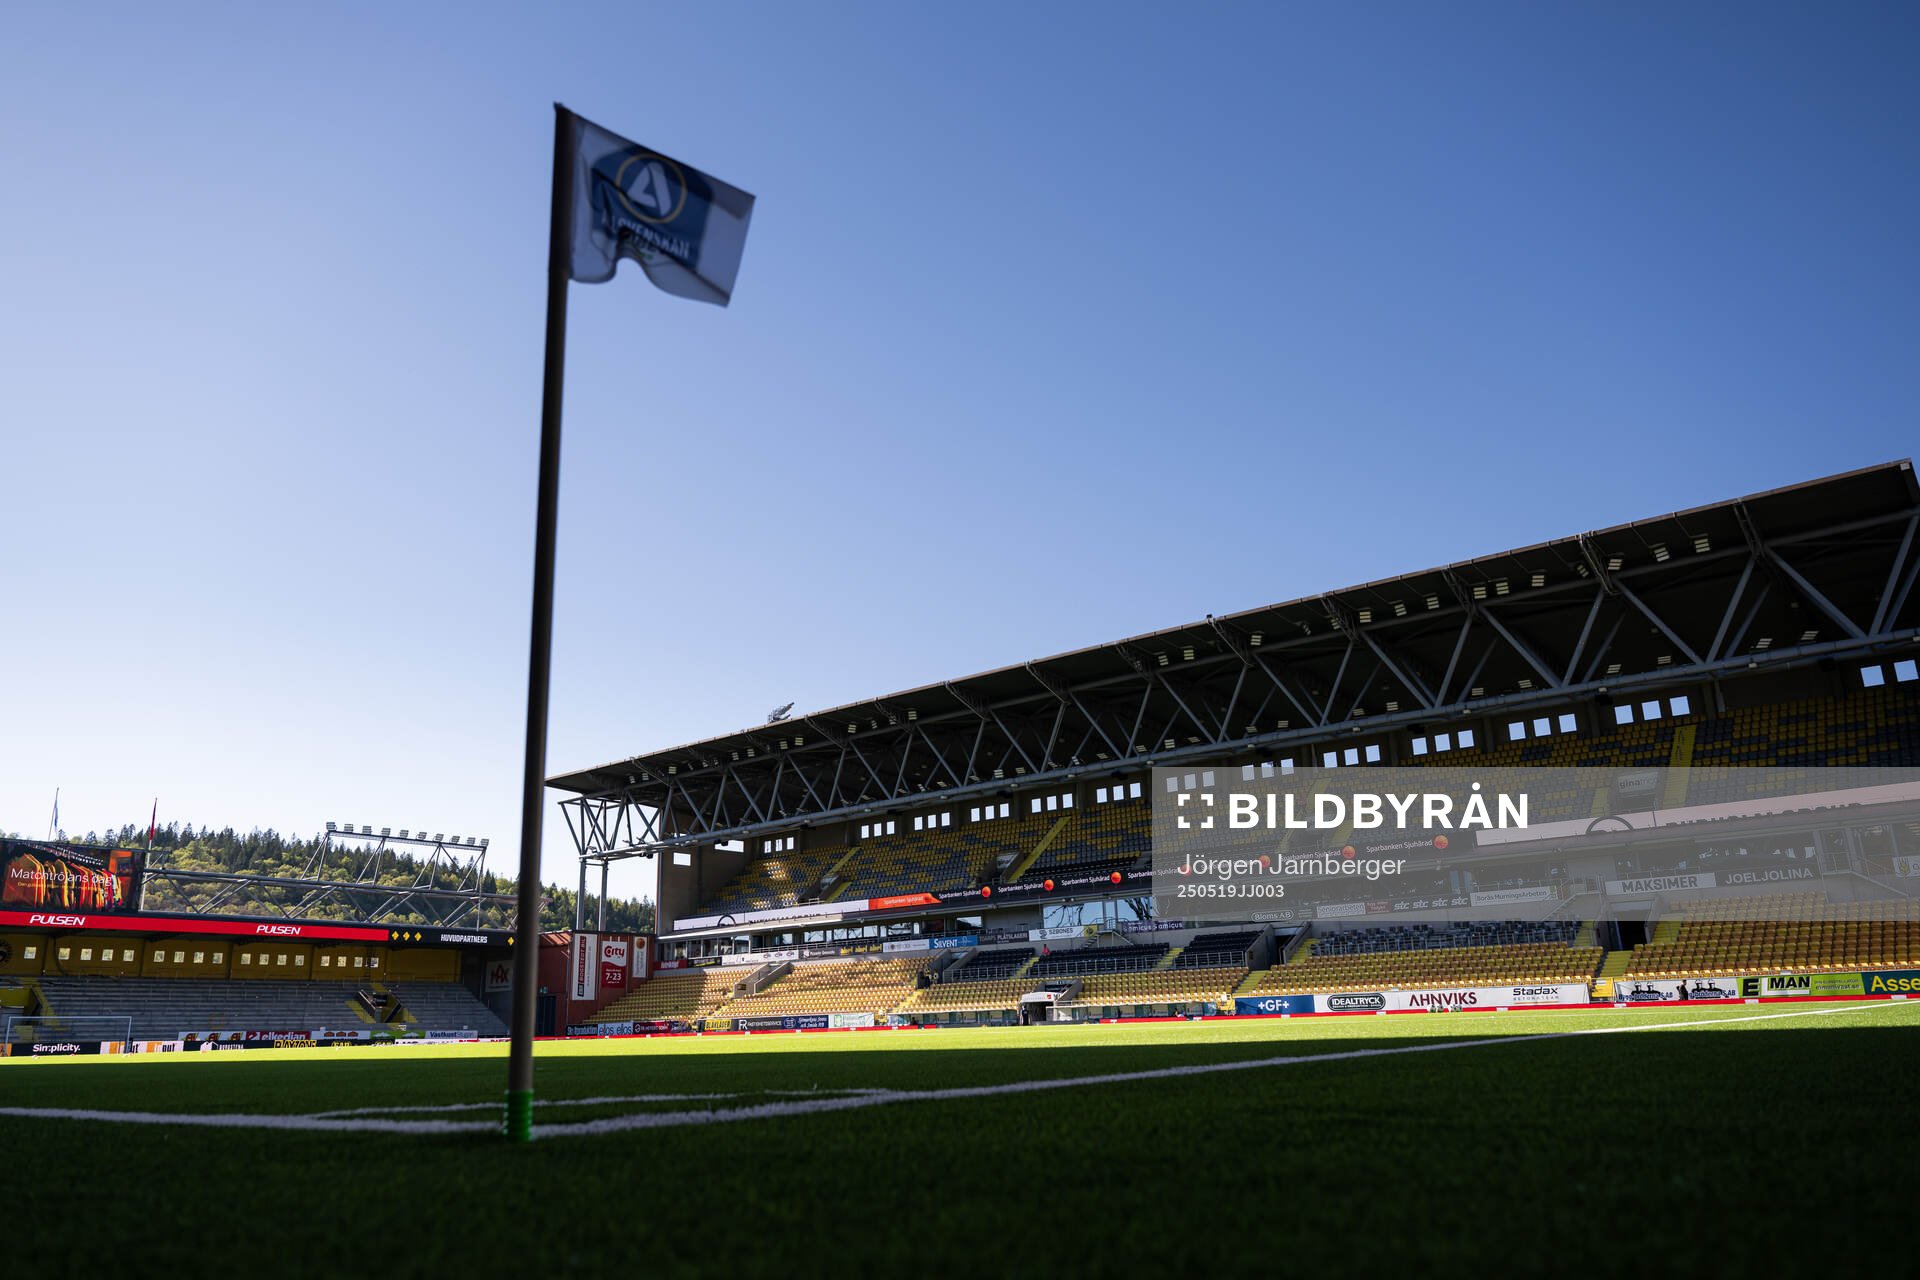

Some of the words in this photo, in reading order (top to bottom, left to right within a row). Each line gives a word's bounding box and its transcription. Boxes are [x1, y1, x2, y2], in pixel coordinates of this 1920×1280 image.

[1366, 844, 1403, 854] Sparbanken
[11, 868, 88, 883] Matchtröans
[1725, 867, 1813, 885] JOELJOLINA
[1062, 878, 1088, 886] Sparbanken
[1621, 875, 1698, 894] MAKSIMER
[998, 885, 1023, 893] Sparbanken
[29, 914, 86, 926] PULSEN
[256, 925, 301, 935] PULSEN
[441, 934, 488, 944] HUVUDPARTNERS
[604, 945, 625, 958] City
[1871, 975, 1920, 992] Asse
[1513, 987, 1558, 996] Stadax
[1331, 996, 1381, 1005] IDEALTRYCK
[1409, 992, 1477, 1006] AHNVIKS
